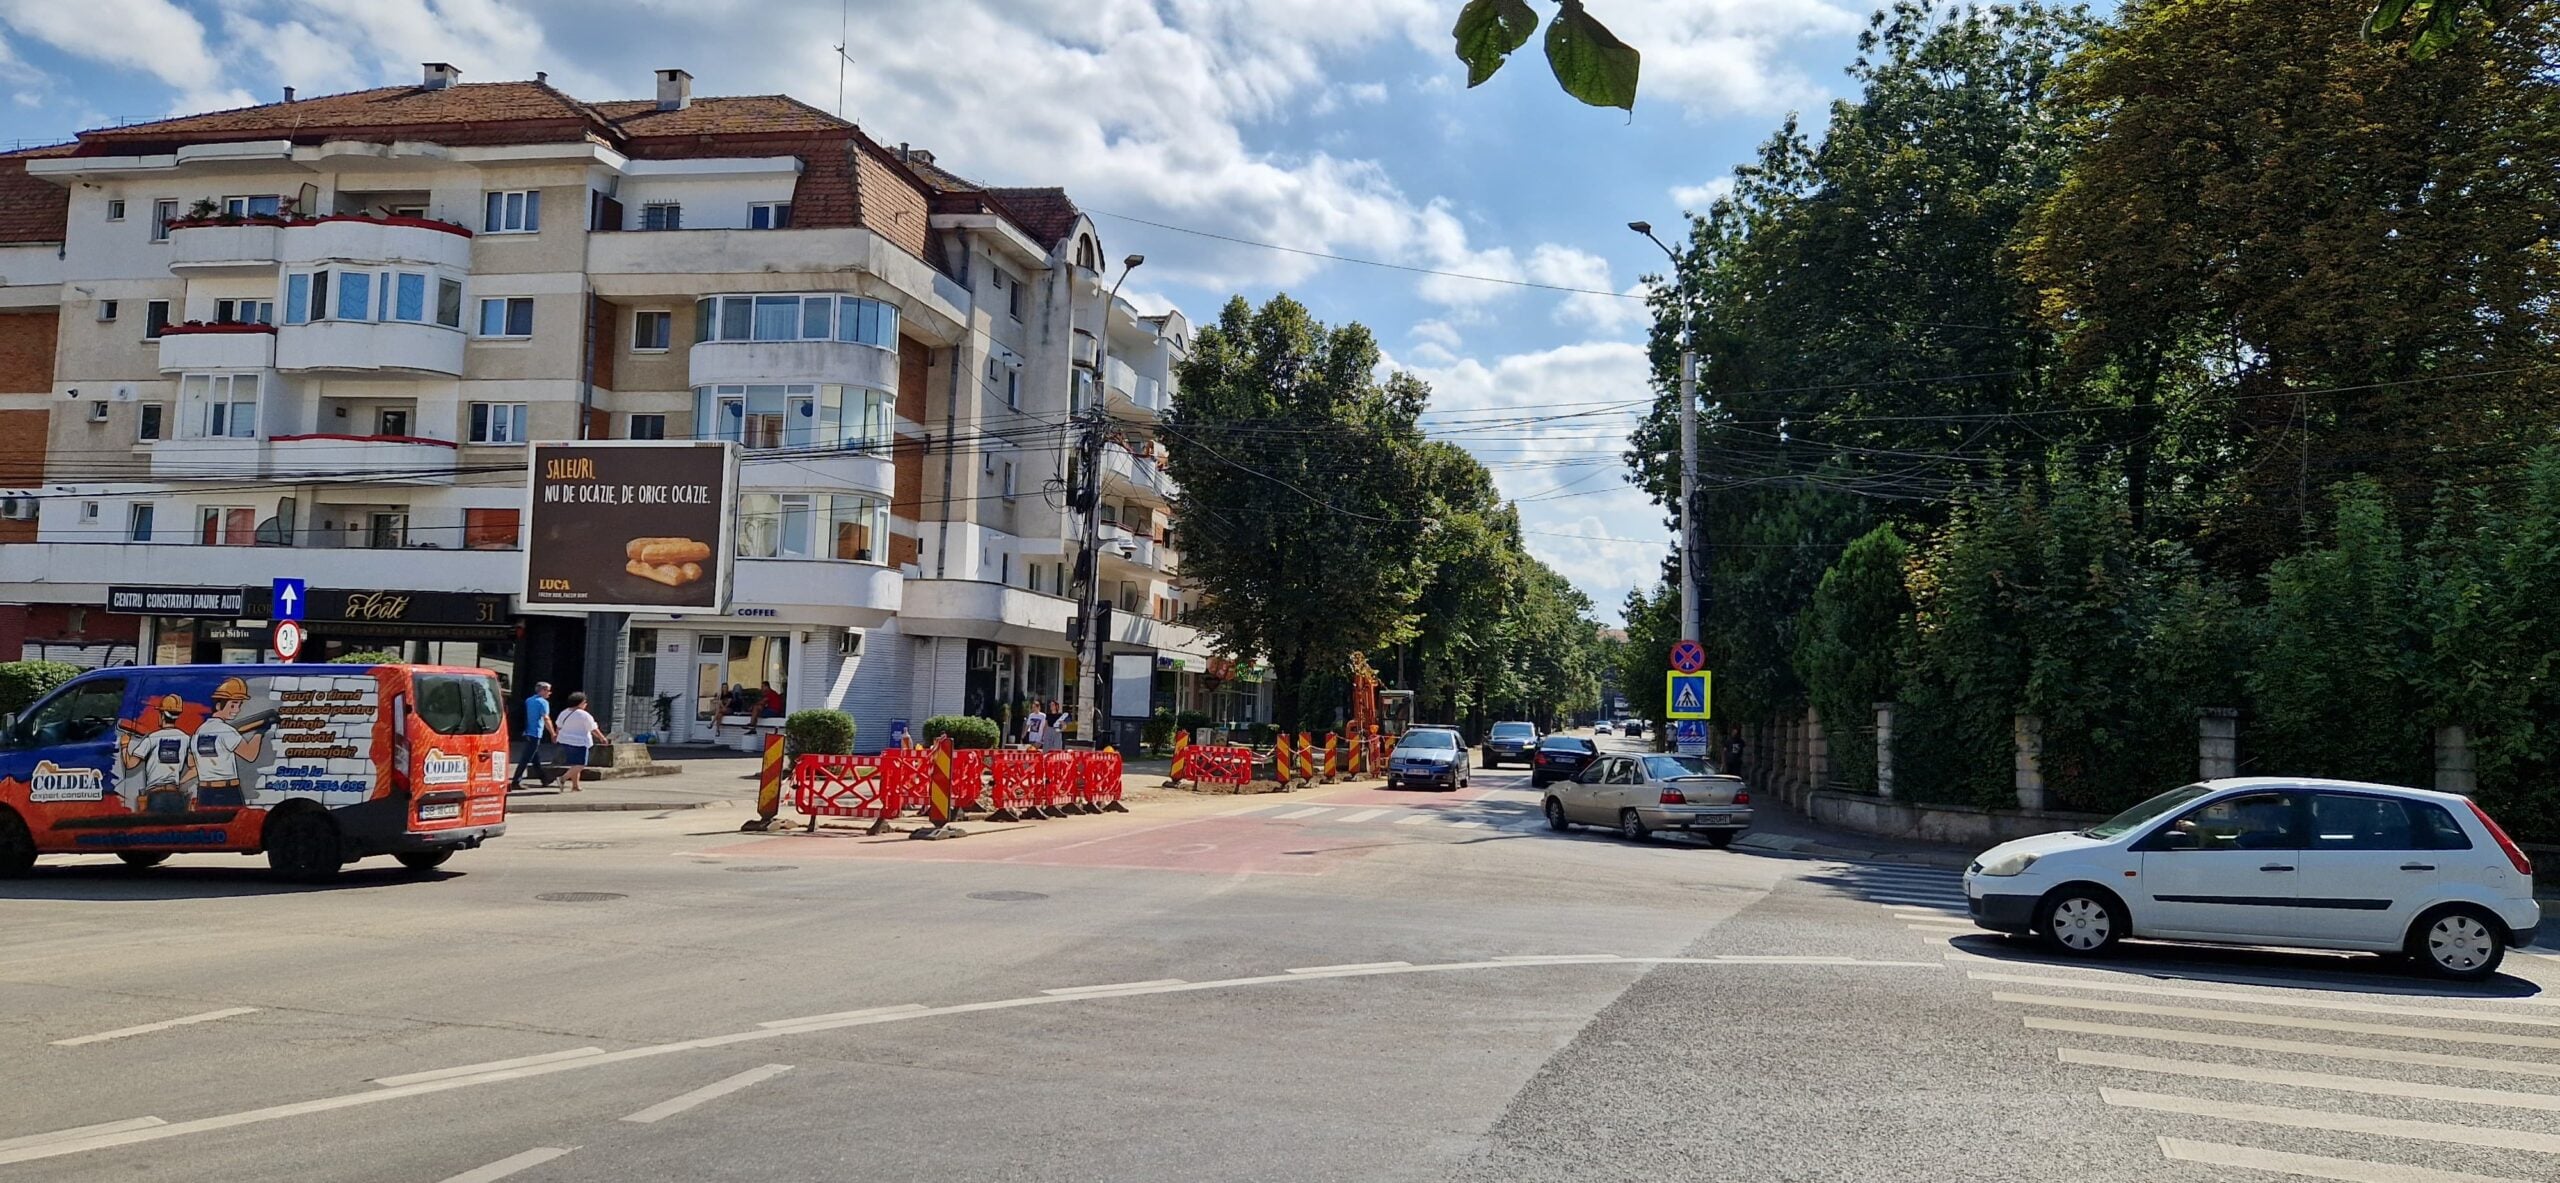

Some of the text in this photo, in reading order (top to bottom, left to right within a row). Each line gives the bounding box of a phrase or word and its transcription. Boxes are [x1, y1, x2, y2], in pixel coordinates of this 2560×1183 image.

[546, 458, 596, 479] SALEURI.
[544, 485, 711, 505] NU DE OCAZIE, DE ORICE OCAZIE.
[539, 579, 570, 590] LUCA
[113, 592, 241, 609] CENTRU CONSTATARI DAUNE AUTO
[475, 602, 495, 621] 31
[737, 608, 776, 617] COFFEE
[426, 760, 467, 773] COLDEA
[32, 775, 101, 790] COLDEA
[31, 791, 101, 802] expert construct
